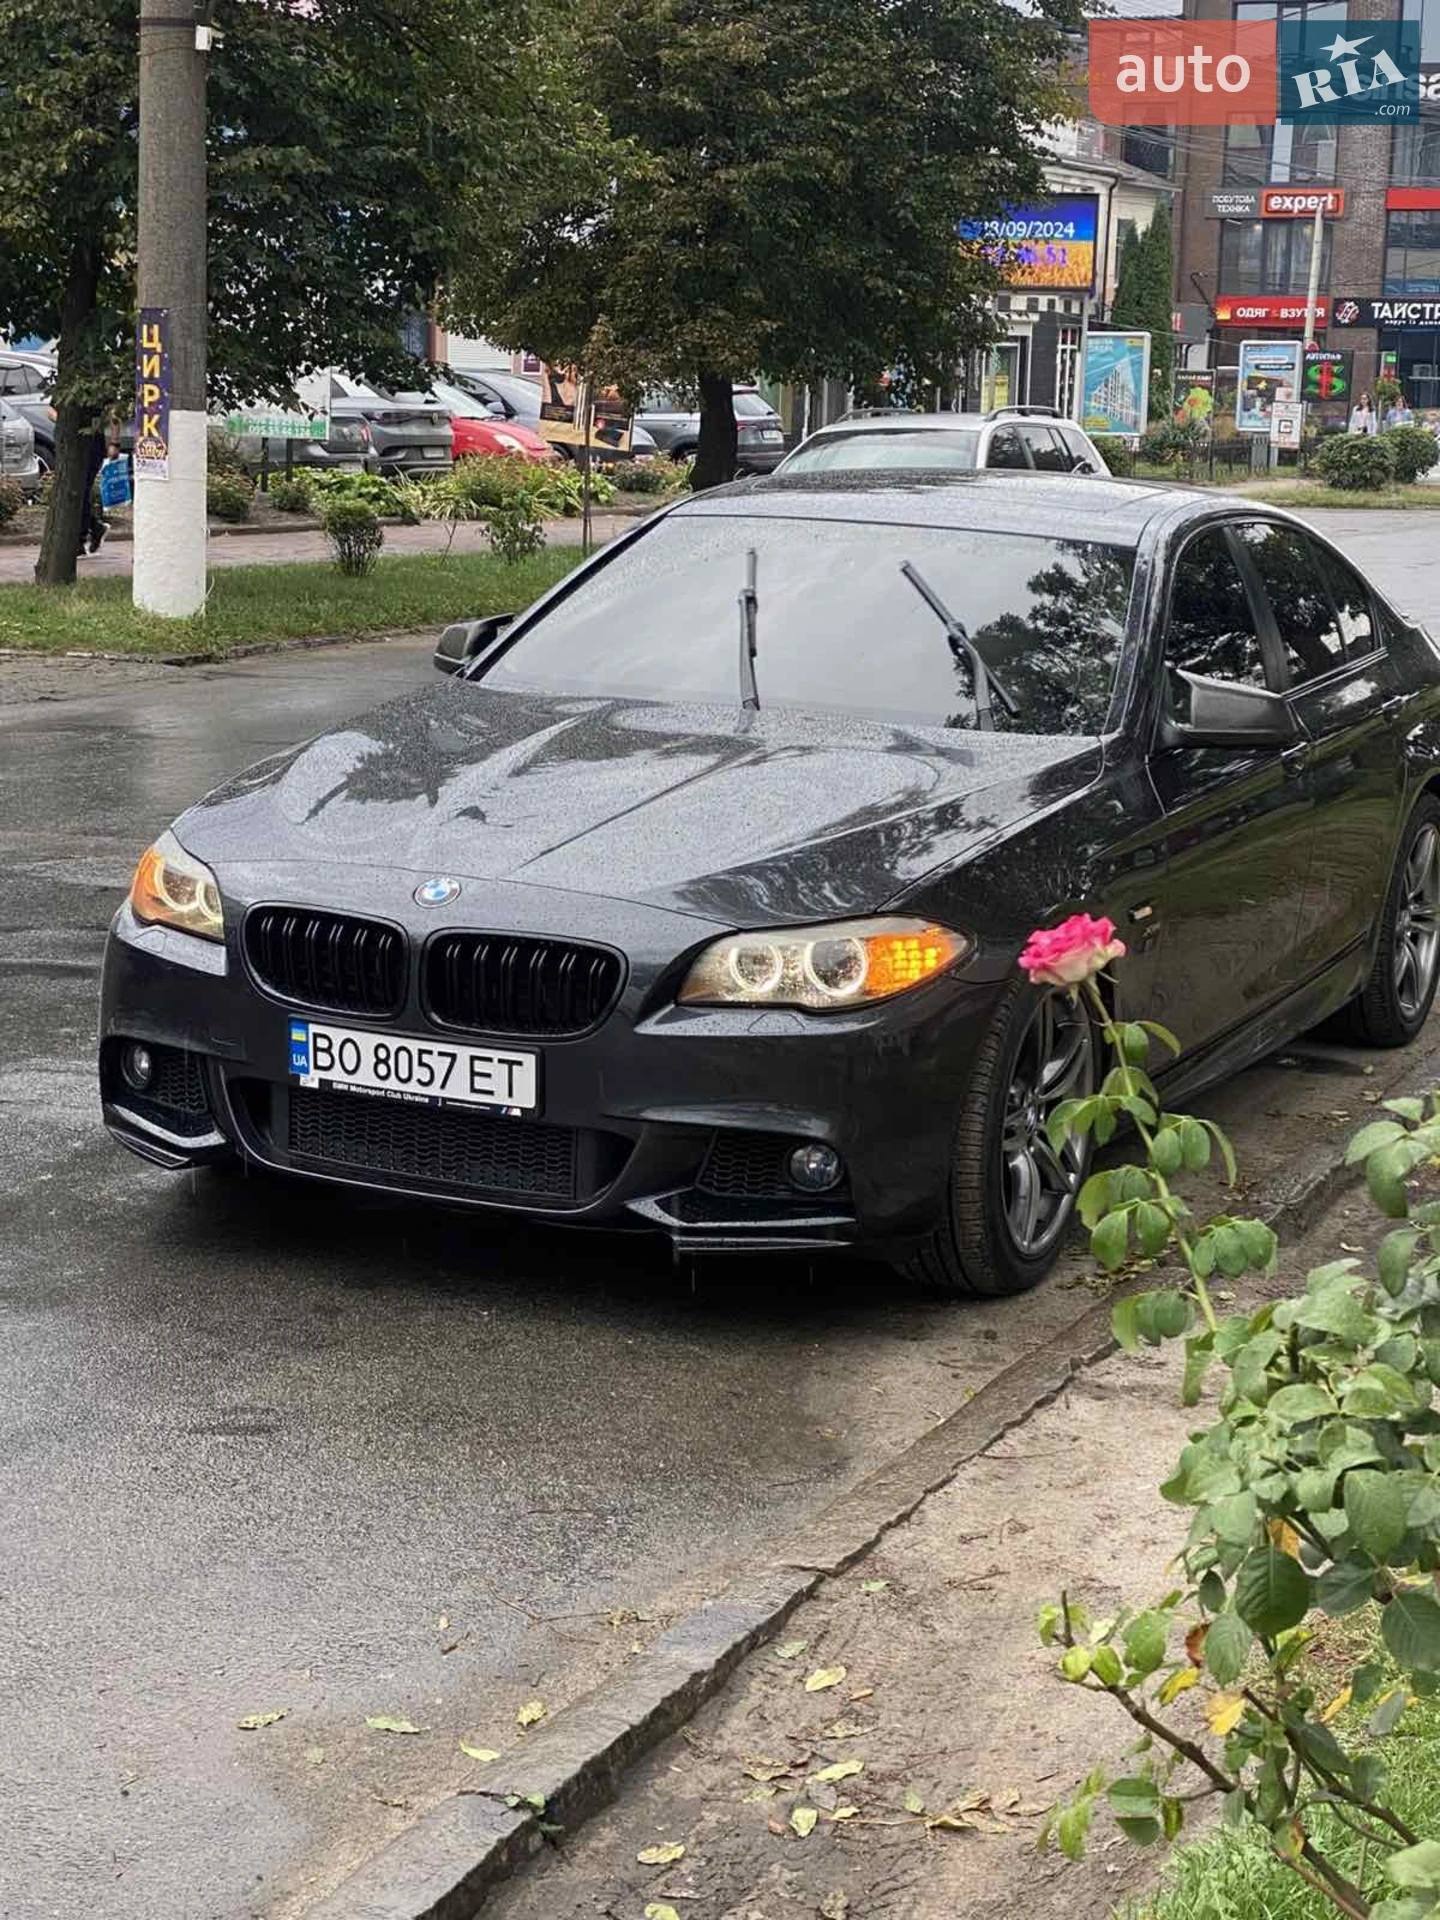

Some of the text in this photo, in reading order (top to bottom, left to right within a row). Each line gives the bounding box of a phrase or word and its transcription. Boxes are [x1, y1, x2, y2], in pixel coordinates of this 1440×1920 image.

[1212, 195, 1255, 203] ПОБУТОВА
[1270, 192, 1334, 214] expert
[1236, 307, 1325, 318] ОДЯГ ВЗУТЯ
[141, 323, 162, 438] ЦИРК
[293, 1055, 308, 1067] UA
[312, 1032, 524, 1099] BO 8057 ET
[349, 1084, 385, 1097] Motorsport
[386, 1091, 402, 1100] Club
[402, 1093, 429, 1103] Ukraine
